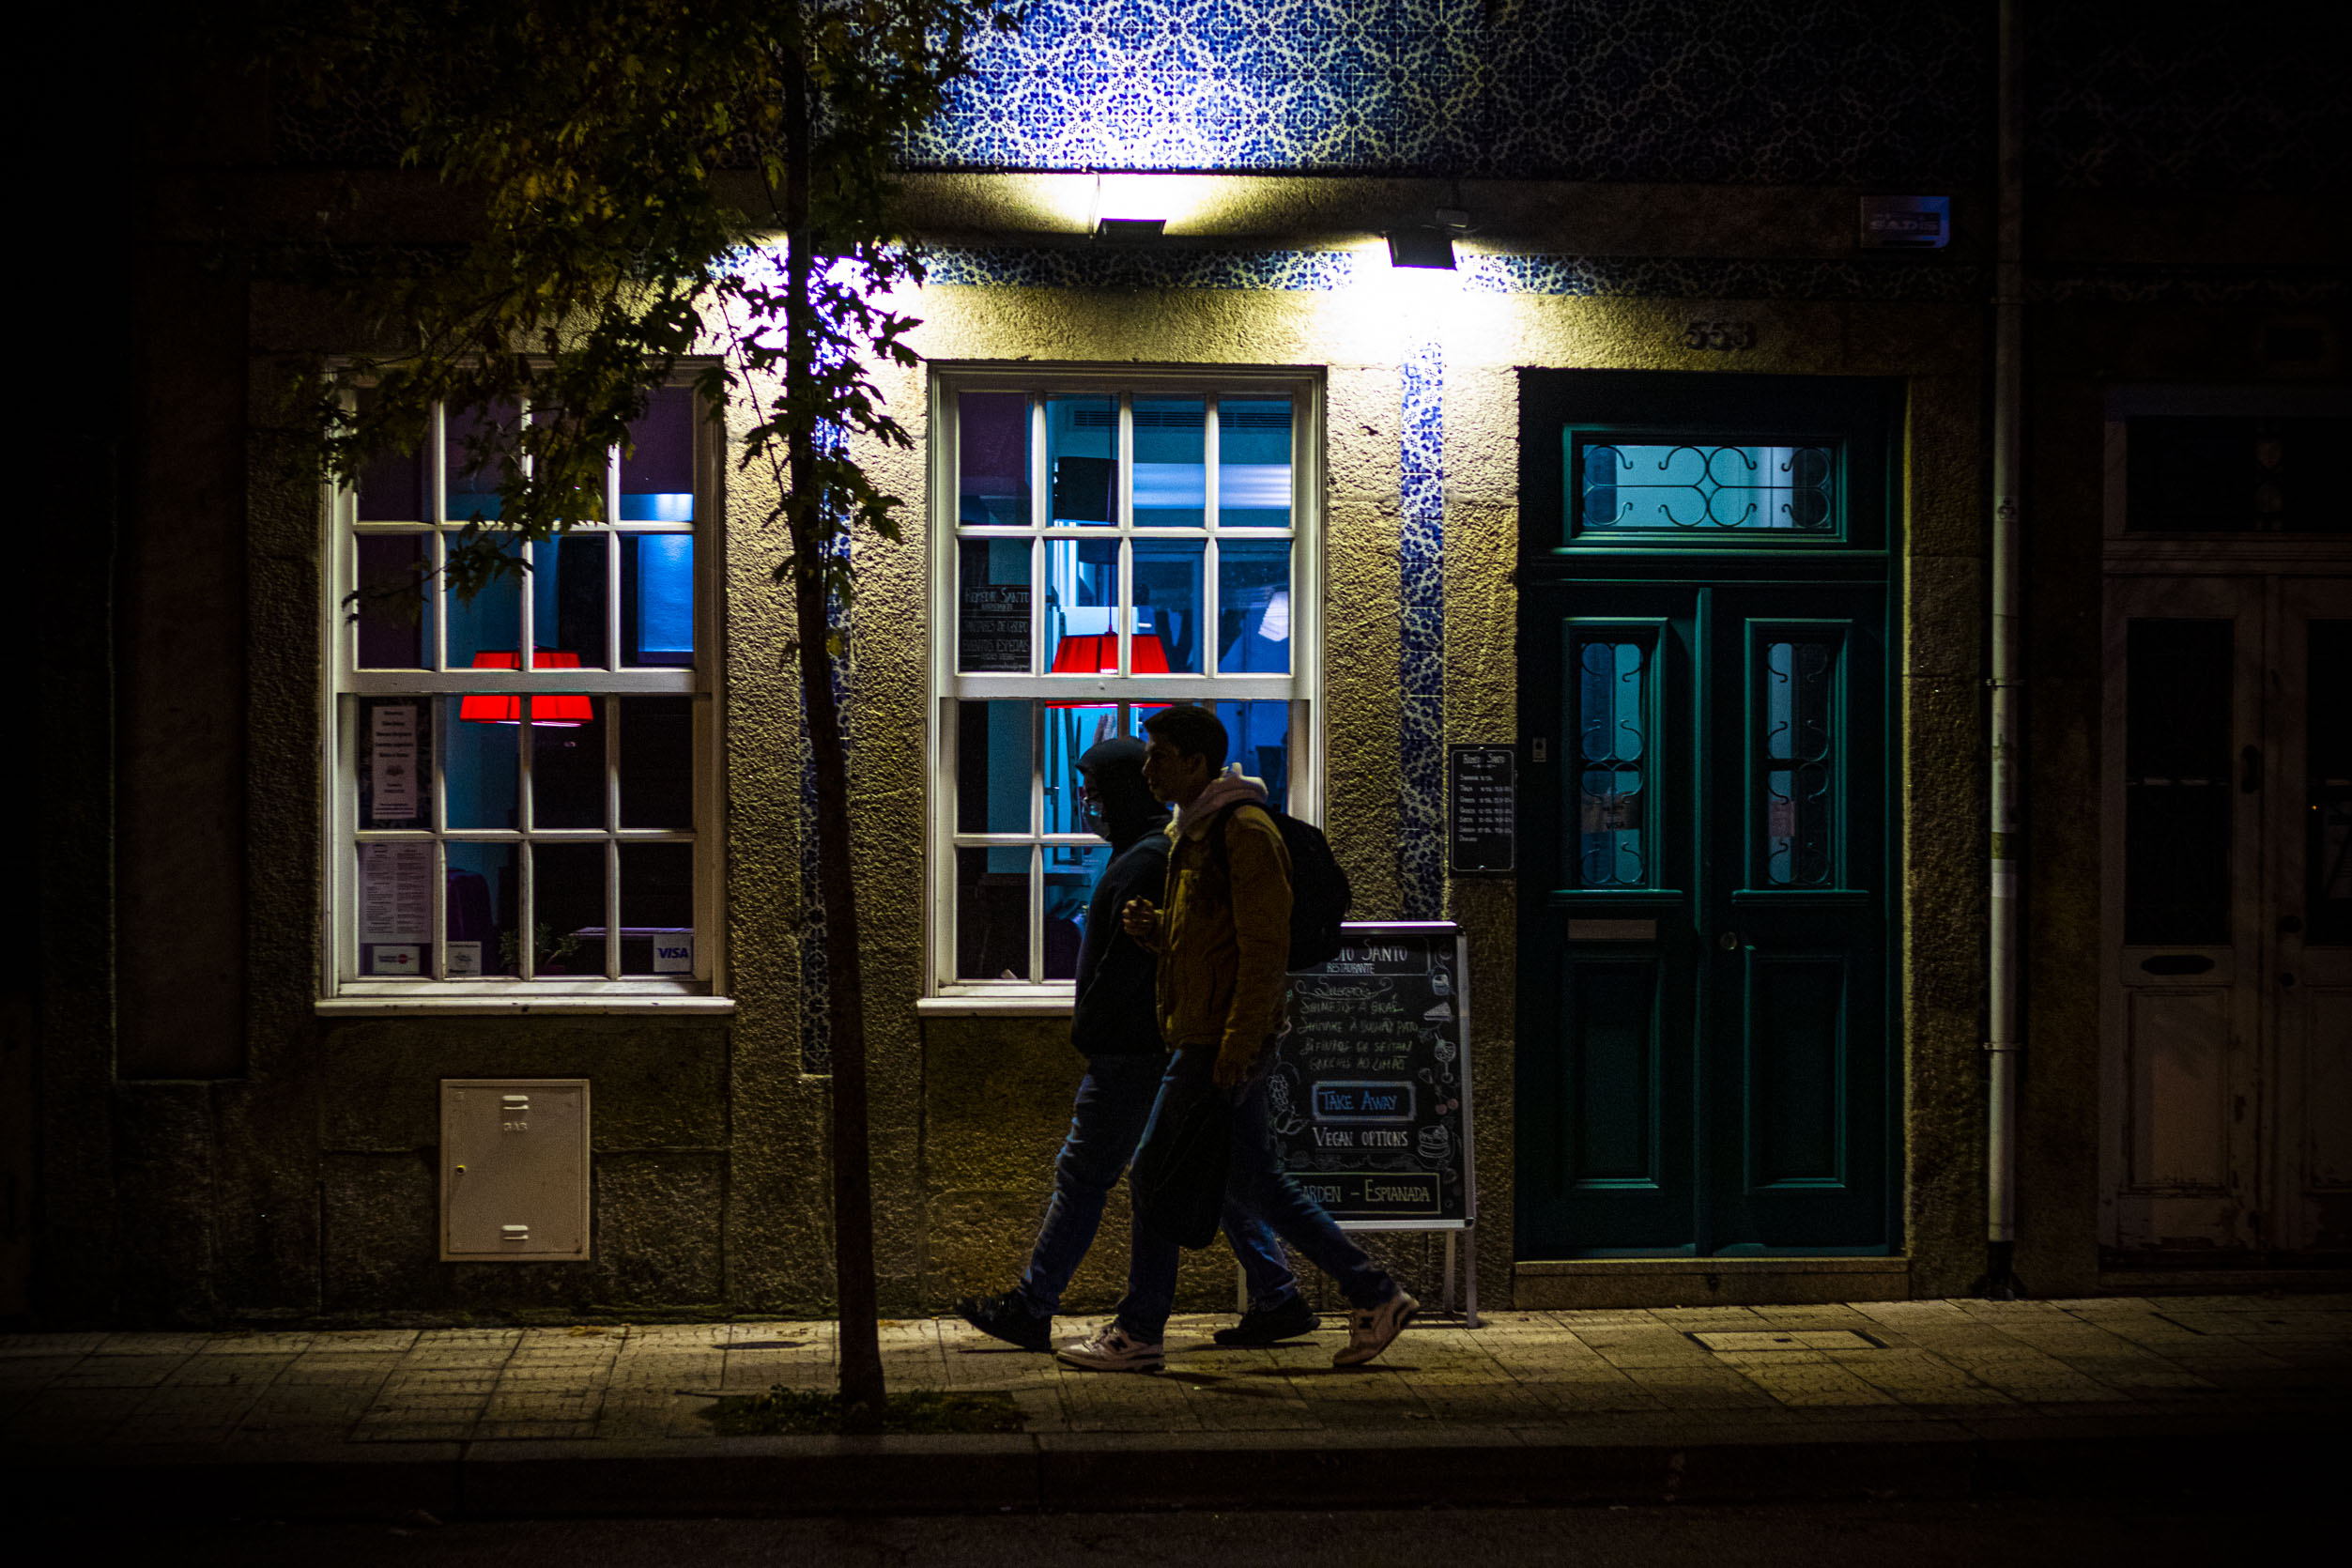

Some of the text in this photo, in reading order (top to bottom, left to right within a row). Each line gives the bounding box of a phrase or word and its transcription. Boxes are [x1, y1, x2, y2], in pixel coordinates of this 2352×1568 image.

[656, 947, 689, 959] VISA
[1362, 938, 1408, 962] SANTO
[1317, 1089, 1397, 1111] TAKE AWAY
[1312, 1127, 1408, 1146] VEGAN OPTIONS
[1301, 1185, 1342, 1203] ARDEN
